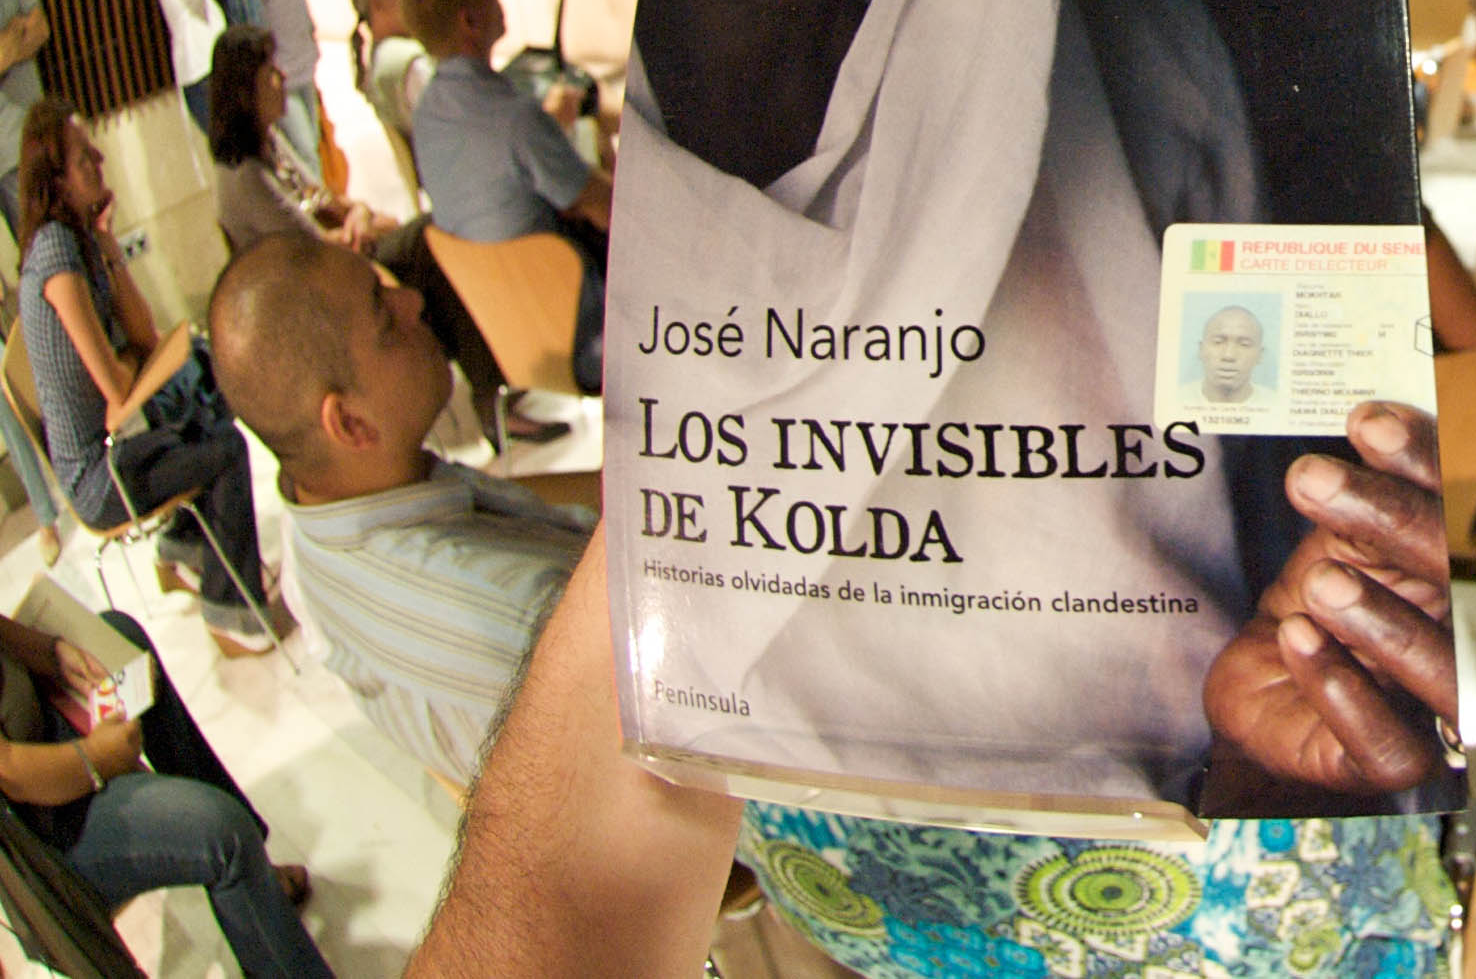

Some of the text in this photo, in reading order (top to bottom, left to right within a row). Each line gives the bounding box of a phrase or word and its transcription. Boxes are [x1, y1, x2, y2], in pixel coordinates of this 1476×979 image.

[1240, 258, 1288, 271] CARTE
[1242, 241, 1348, 254] REPUBLIQUE
[1353, 241, 1376, 254] DU
[639, 305, 986, 378] José Naranjo
[638, 398, 1206, 479] LOS INVISIBLES
[640, 486, 963, 564] DE KOLDA
[643, 559, 1199, 615] Historias olvidadas de la inmigración clandestina
